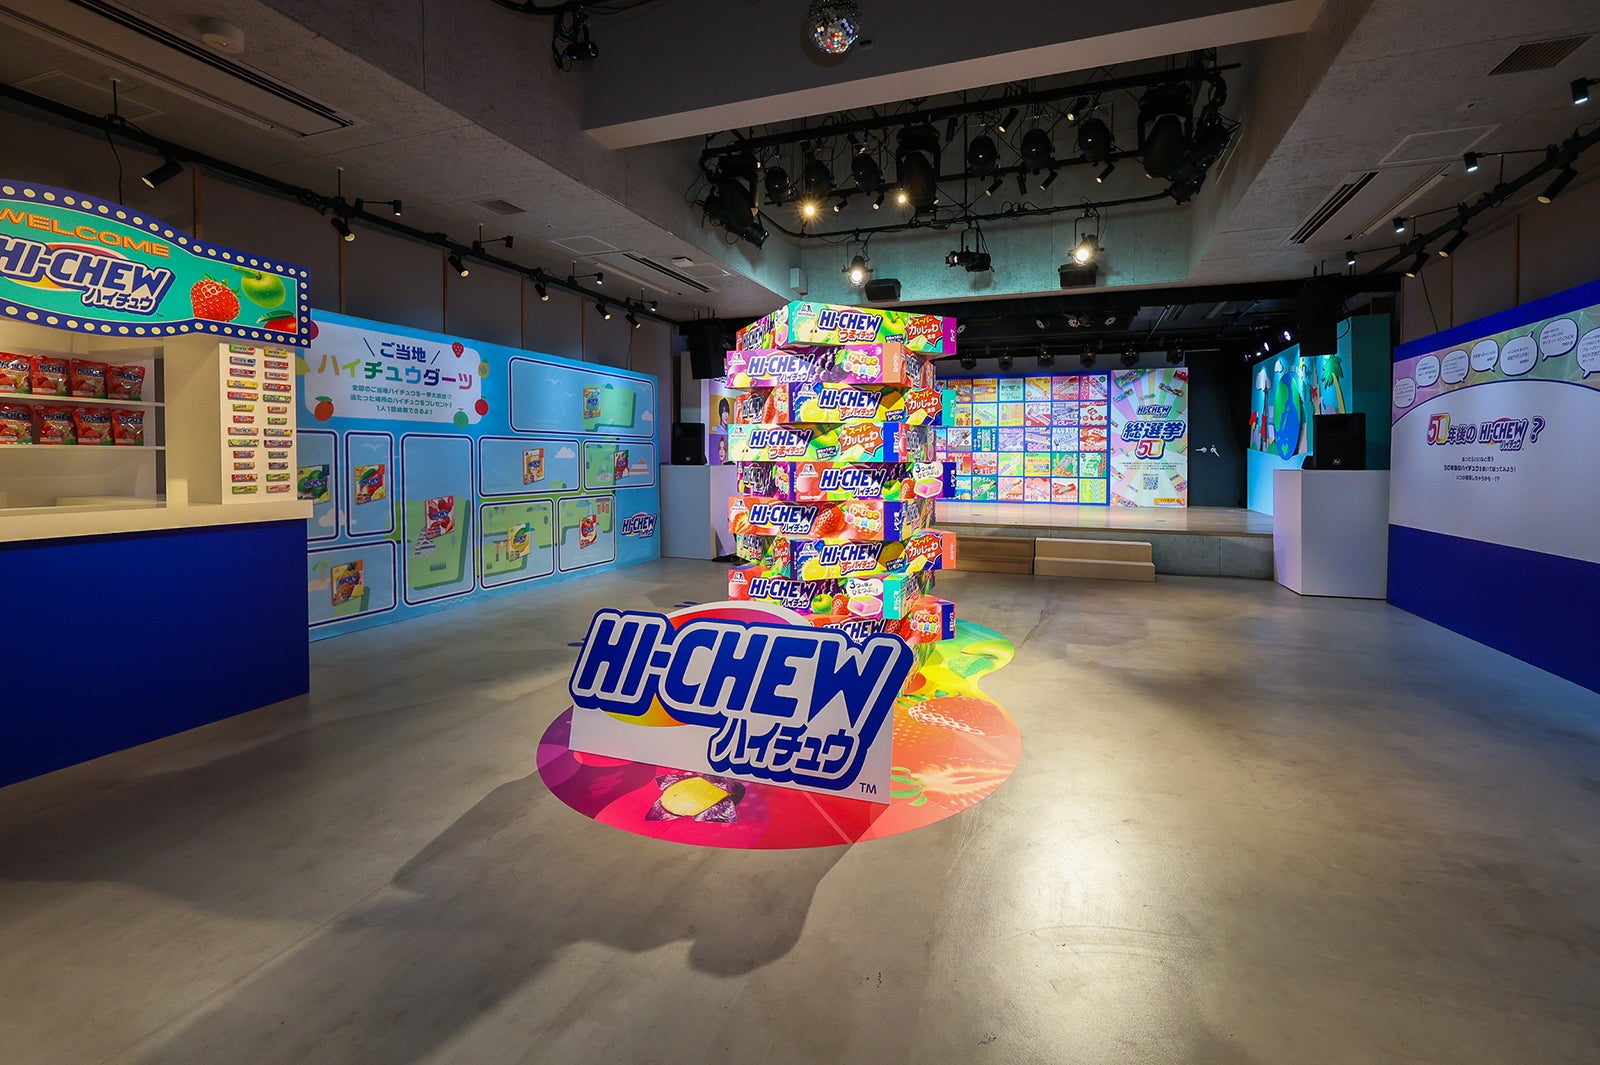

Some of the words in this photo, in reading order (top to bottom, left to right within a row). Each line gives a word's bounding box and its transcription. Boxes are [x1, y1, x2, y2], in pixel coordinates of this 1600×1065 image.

[0, 208, 170, 258] WELCOME
[84, 288, 154, 311] ハイチュウ
[819, 310, 882, 332] HI-CHEW
[380, 341, 427, 363] ご当地
[318, 354, 473, 390] ハイチュウダーツ
[748, 354, 814, 375] HI-CHEW
[819, 389, 882, 408] HI-CHEW
[915, 391, 933, 399] スーパー
[1138, 405, 1171, 415] HI-CHEW
[750, 430, 813, 448] HI-CHEW
[1123, 421, 1184, 440] 総選挙
[1480, 420, 1527, 441] HI-CHEW
[1530, 416, 1544, 441] ?
[1137, 440, 1163, 457] 50
[820, 468, 887, 490] HI-CHEW
[622, 514, 657, 534] HI-CHEW
[750, 504, 817, 525] HI-CHEW
[782, 522, 809, 533] ハイチュウ
[914, 537, 933, 546] スーパー
[820, 542, 883, 565] HI-CHEW
[750, 578, 817, 600] HI-CHEW
[782, 597, 810, 609] ハイチュウ
[574, 616, 898, 729] HI-CHEW
[713, 716, 856, 774] ハイチュウ
[859, 782, 877, 795] TM
